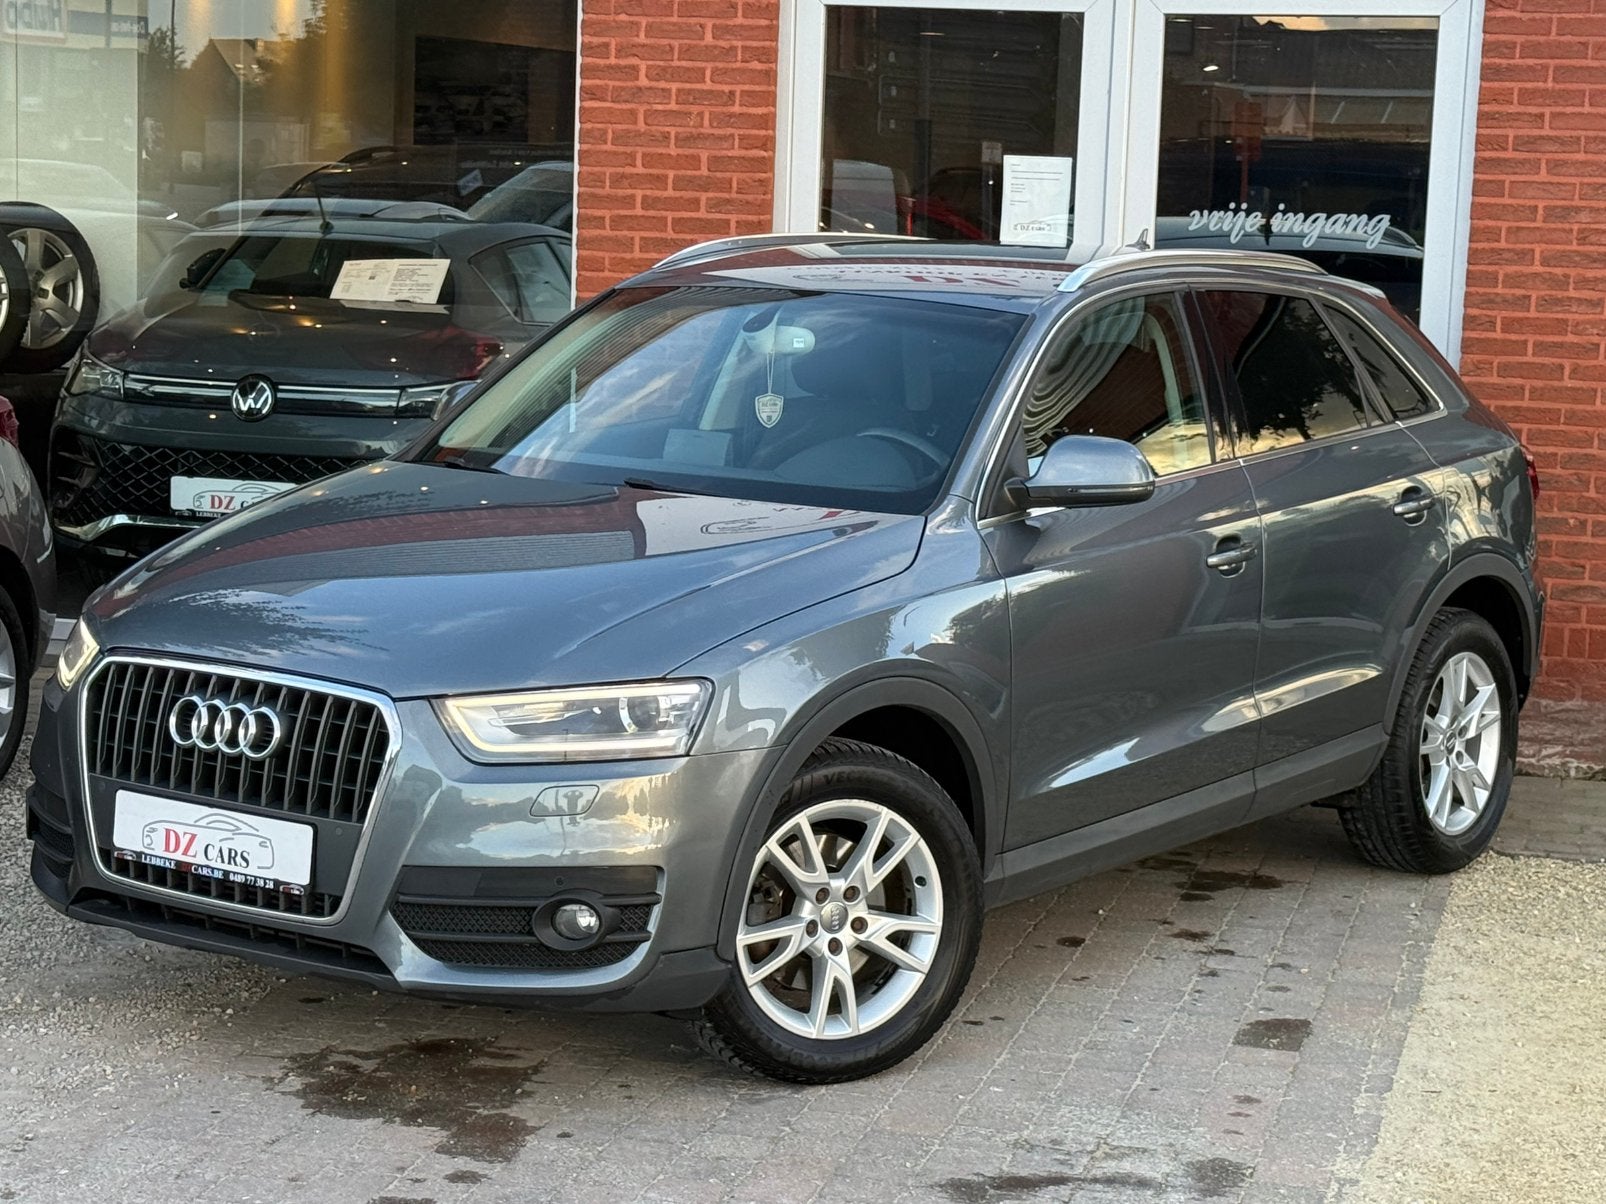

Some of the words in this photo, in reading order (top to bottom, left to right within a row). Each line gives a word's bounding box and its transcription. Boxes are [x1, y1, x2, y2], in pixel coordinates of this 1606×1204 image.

[1188, 202, 1263, 244] vrije
[1270, 203, 1391, 249] ingang
[210, 495, 236, 511] DZ
[163, 828, 198, 858] DZ
[204, 843, 250, 869] CARS
[141, 854, 176, 869] LEBBEKE
[229, 872, 246, 883] 0489
[247, 875, 255, 886] 77
[255, 878, 265, 888] 38
[265, 880, 274, 889] 28
